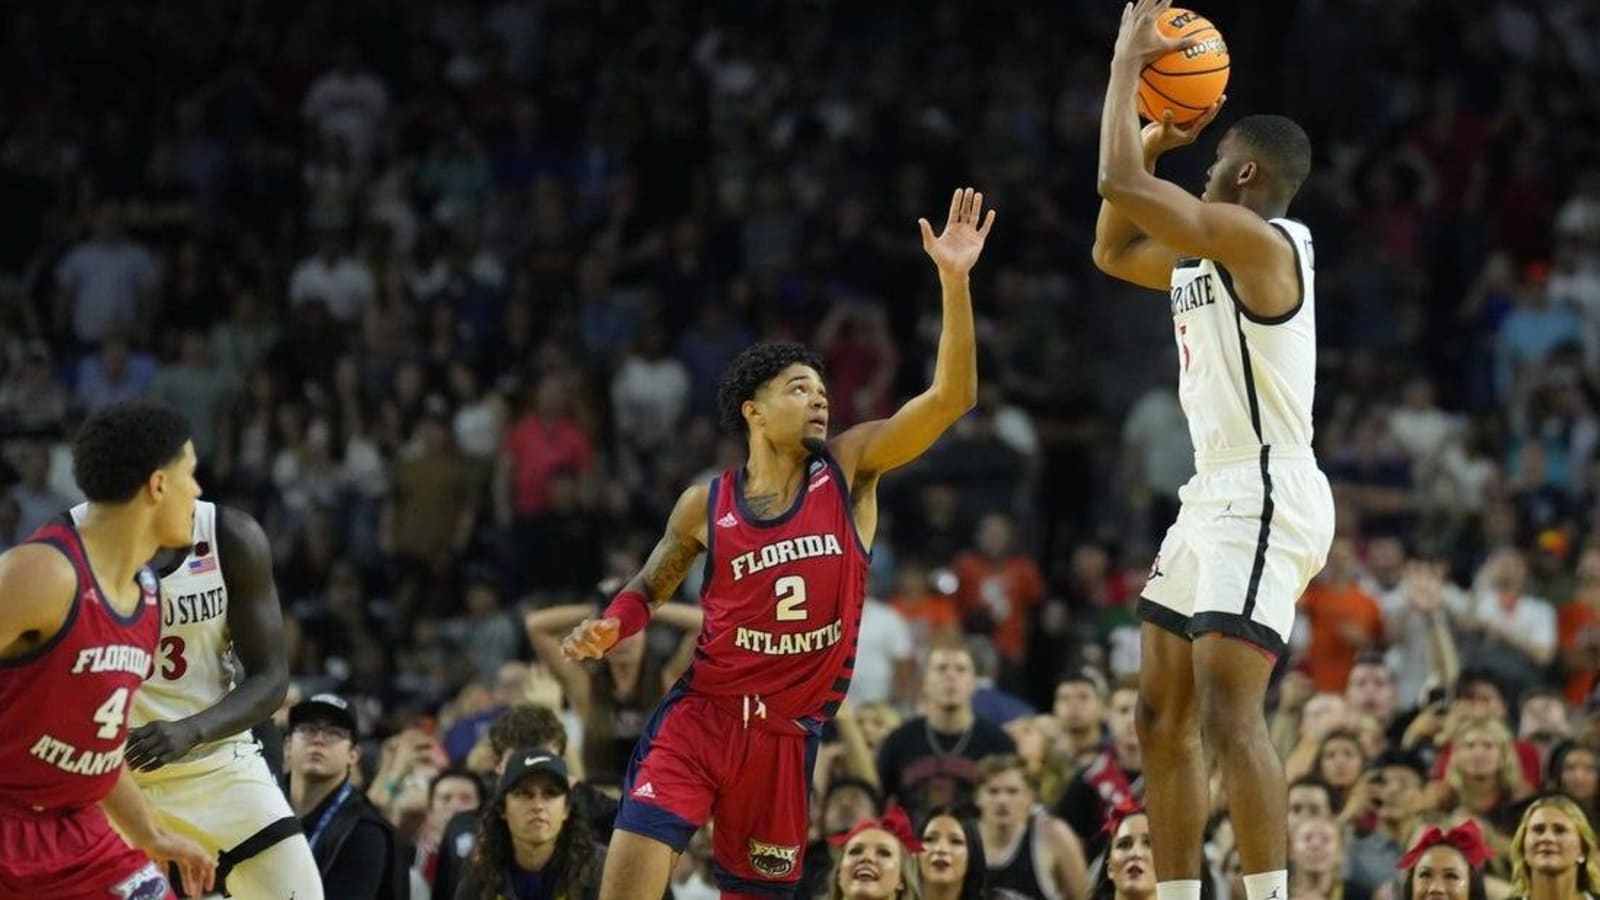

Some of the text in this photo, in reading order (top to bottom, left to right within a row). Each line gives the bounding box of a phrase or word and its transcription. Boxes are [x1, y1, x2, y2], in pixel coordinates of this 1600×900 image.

[731, 534, 843, 581] FLORIDA
[178, 587, 223, 625] STATE
[775, 575, 807, 621] 2
[145, 635, 187, 680] 3
[735, 618, 842, 655] ATLANTIC
[93, 687, 129, 739] 4
